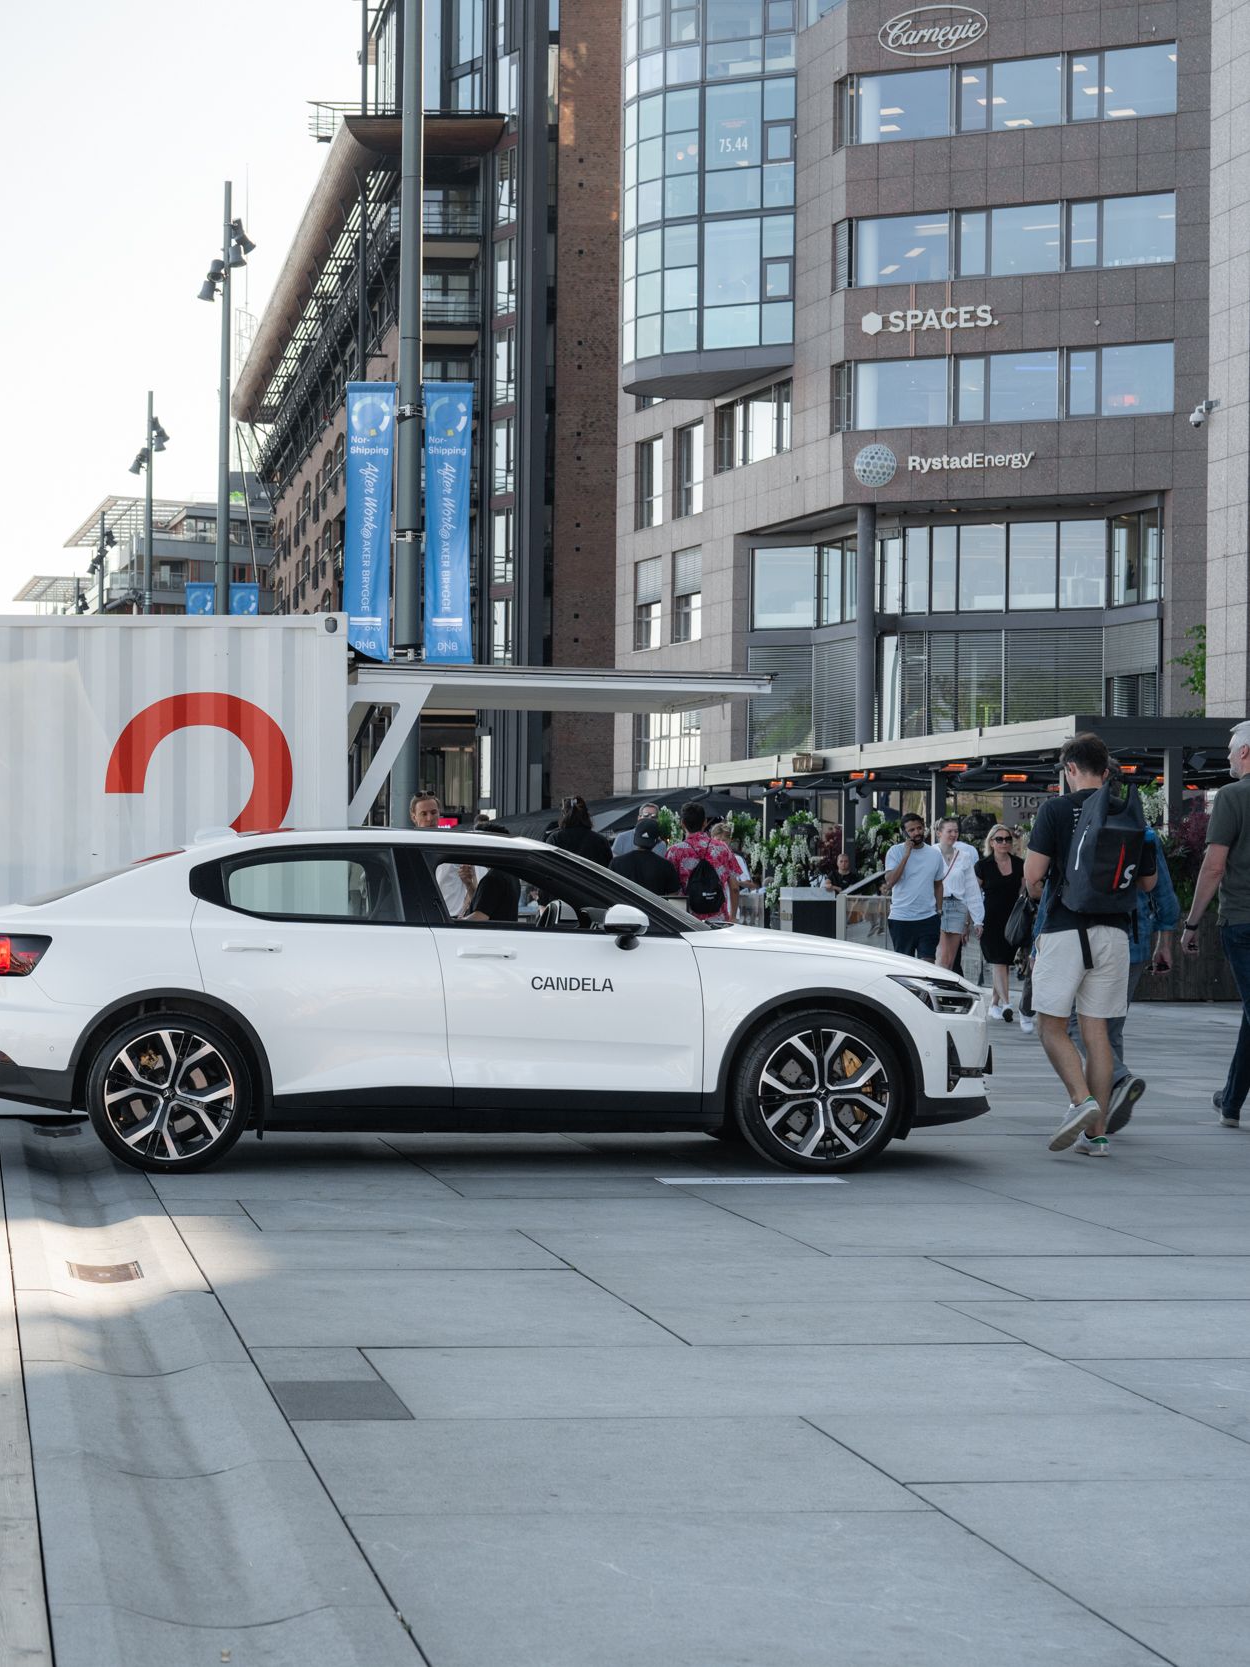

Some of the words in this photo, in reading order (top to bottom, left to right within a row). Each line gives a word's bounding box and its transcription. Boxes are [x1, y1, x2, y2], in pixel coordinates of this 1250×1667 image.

[886, 18, 981, 50] Carnegie
[718, 136, 748, 153] 75.44
[888, 304, 999, 333] SPACES.
[350, 436, 371, 444] Nor-
[428, 436, 447, 444] Nor-
[350, 446, 389, 456] Shipping
[428, 446, 467, 456] Shipping
[907, 451, 1036, 474] RystadEnergy
[359, 461, 380, 495] After
[436, 462, 456, 495] After
[361, 541, 371, 567] AKER
[440, 541, 451, 567] AKER
[360, 569, 371, 612] BRYGGE
[441, 570, 452, 613] BRYGGE
[355, 640, 377, 650] DNB
[437, 640, 459, 653] DNB
[1011, 795, 1039, 809] BIG
[531, 975, 615, 993] CANDELA
